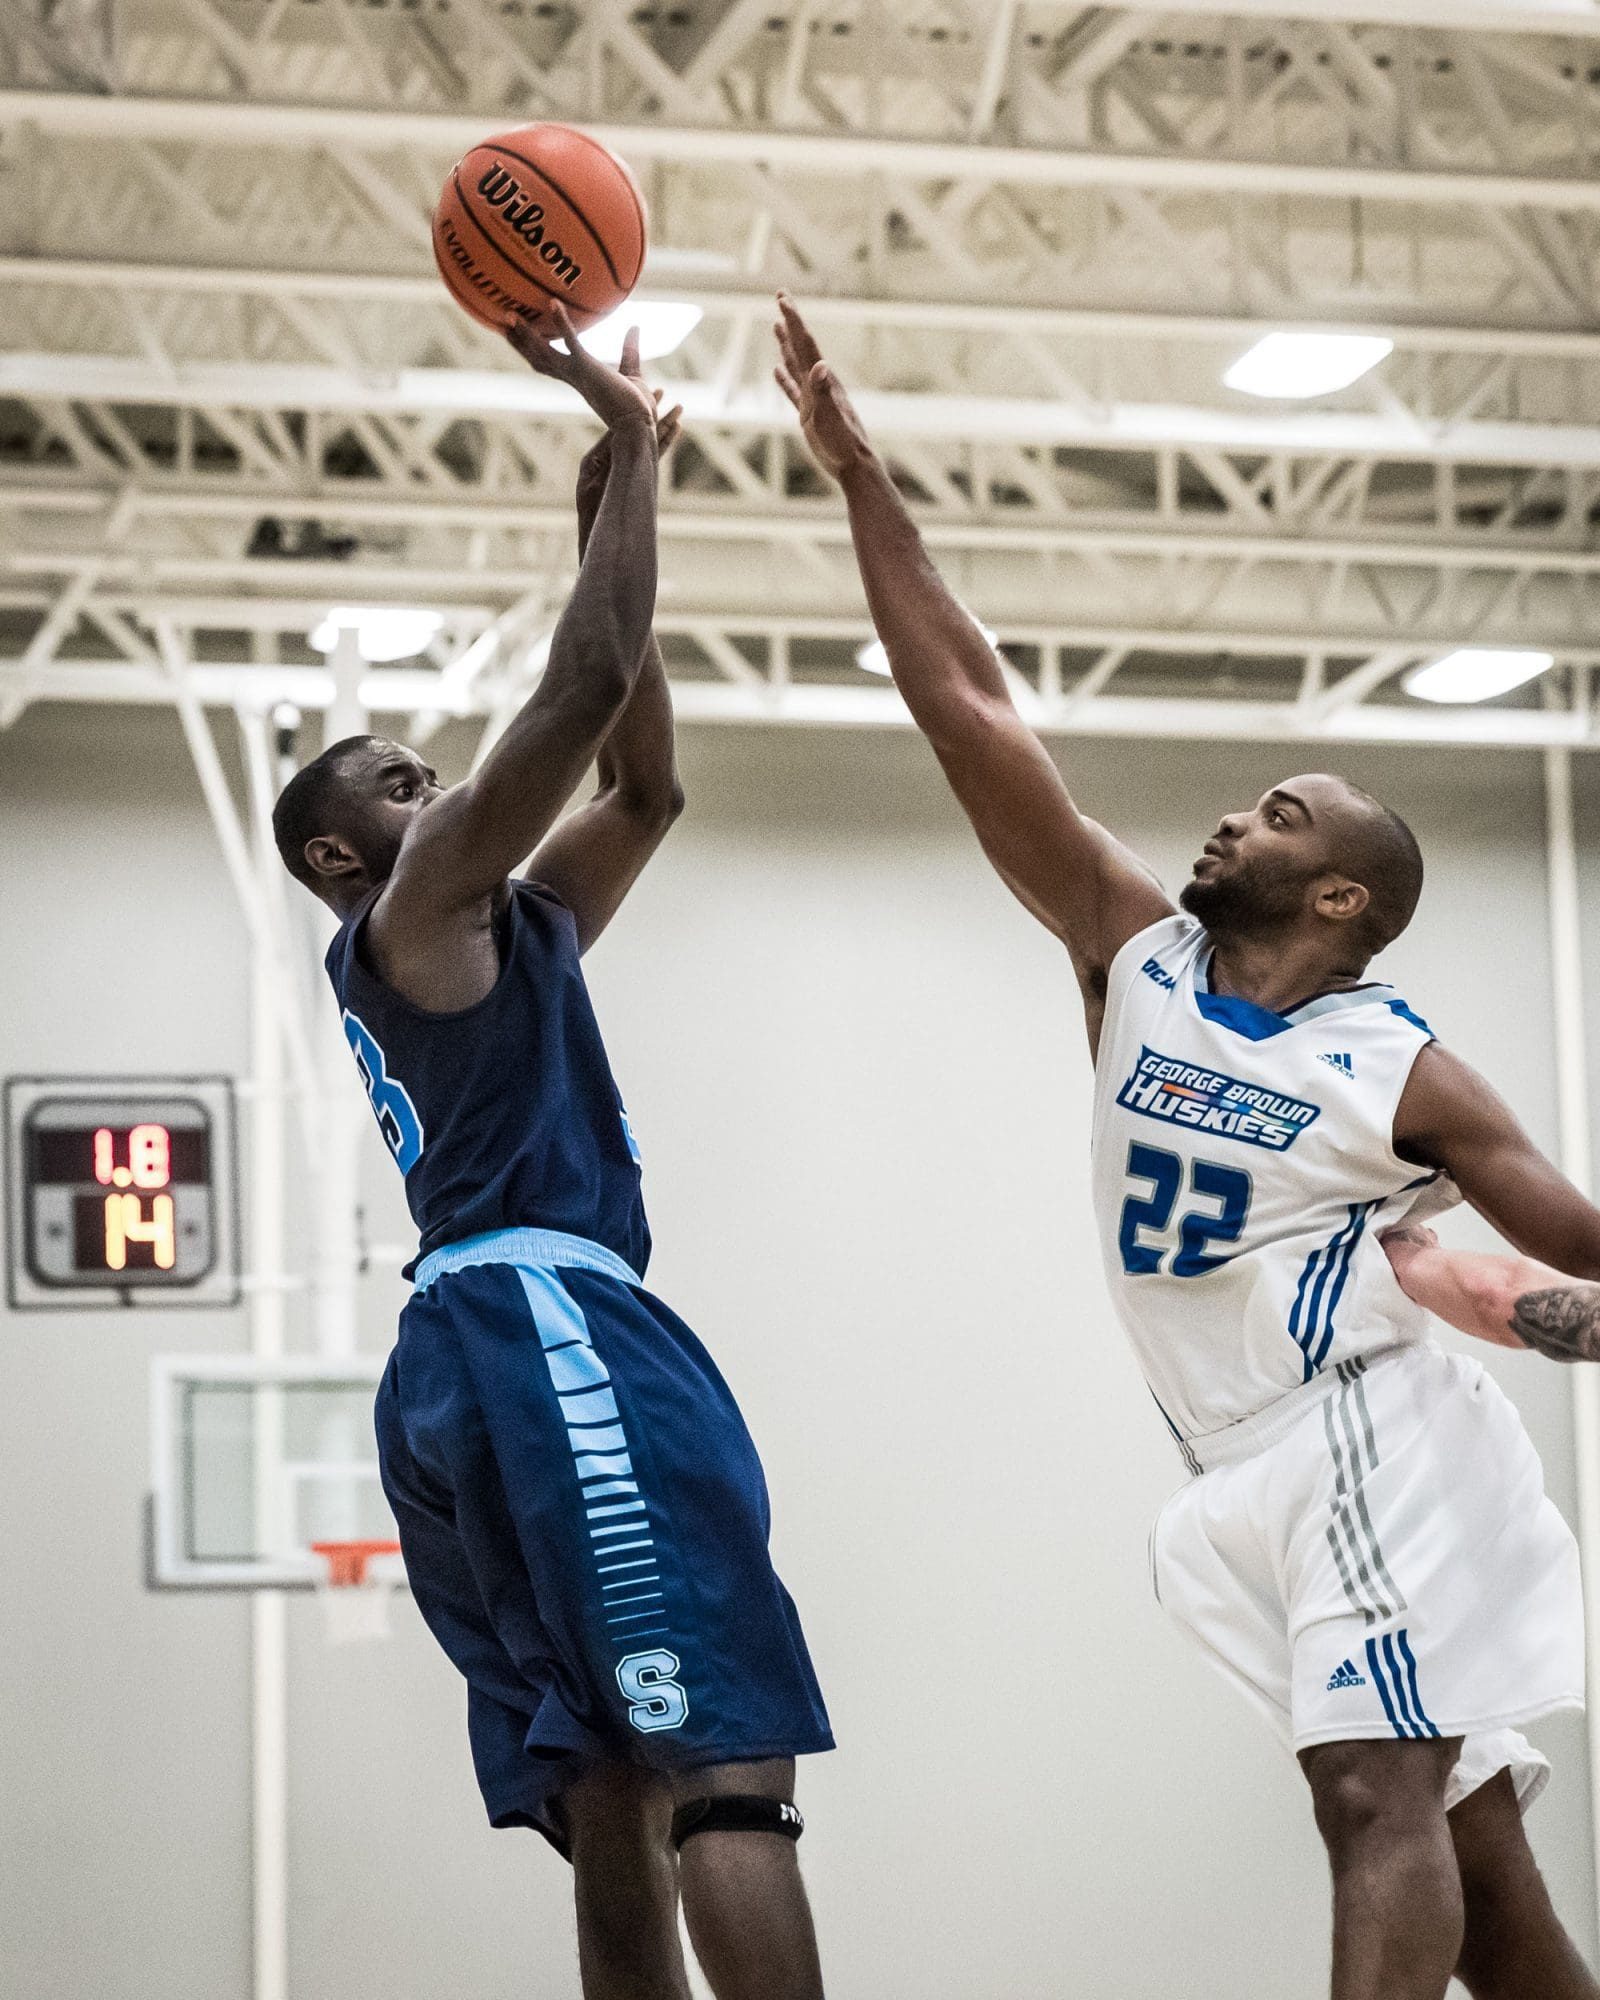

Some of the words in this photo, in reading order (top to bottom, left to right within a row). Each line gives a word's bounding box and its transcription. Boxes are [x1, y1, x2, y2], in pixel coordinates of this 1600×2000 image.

[477, 160, 582, 288] Wilson
[1140, 1055, 1226, 1094] GEORGE
[1223, 1084, 1315, 1124] BROWN
[1316, 1054, 1355, 1080] adidas
[1123, 1073, 1294, 1147] HUSKIES
[94, 1123, 170, 1188] 1.8
[105, 1192, 175, 1270] 14
[1118, 1139, 1253, 1278] 22
[615, 1648, 689, 1734] S
[1327, 1675, 1366, 1691] adidas
